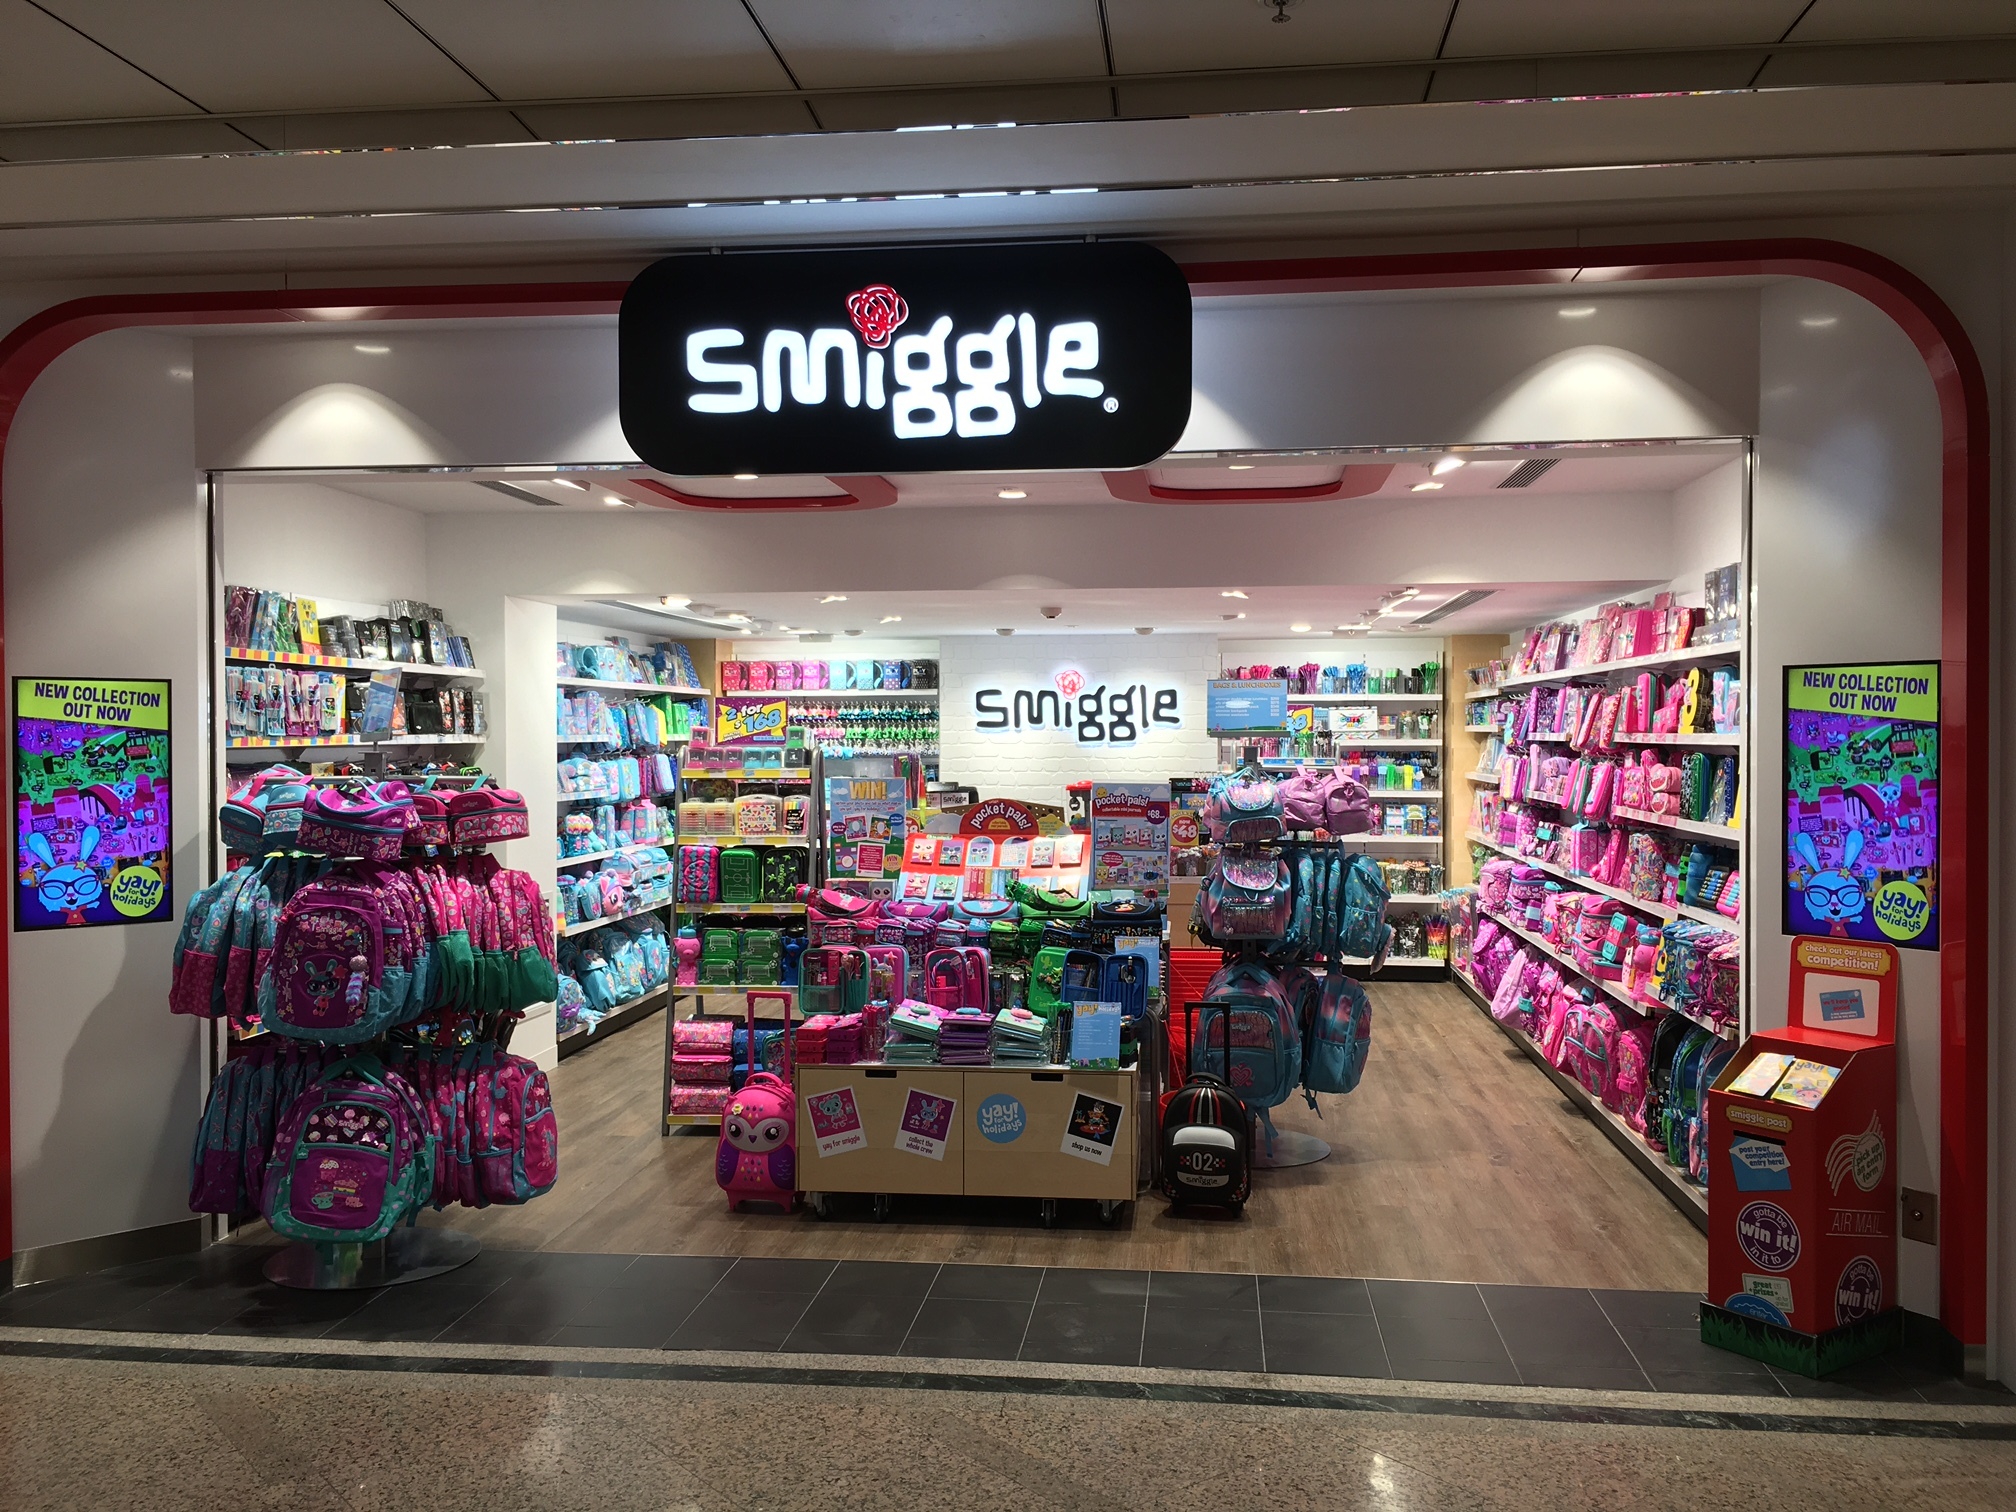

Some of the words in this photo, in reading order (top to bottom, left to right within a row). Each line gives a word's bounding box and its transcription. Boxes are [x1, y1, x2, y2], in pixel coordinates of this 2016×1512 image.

[686, 312, 1105, 439] smiggle
[1803, 671, 1835, 689] NEW
[1838, 673, 1929, 695] COLLECTION
[34, 682, 69, 699] NEW
[72, 685, 161, 708] COLLECTION
[1829, 692, 1858, 710] OUT
[1861, 694, 1898, 713] NOW
[63, 702, 92, 719] OUT
[96, 705, 131, 722] NOW
[725, 708, 738, 721] 2
[741, 703, 763, 718] for
[975, 685, 1180, 742] smiggle
[849, 781, 887, 800] WIN!
[1095, 793, 1128, 809] pocket
[1127, 794, 1150, 807] pals!
[971, 802, 1004, 831] pocket
[1006, 807, 1032, 830] pals!
[1147, 809, 1160, 819] $68
[1172, 824, 1197, 838] $48
[117, 875, 162, 897] yay!
[112, 890, 156, 909] holidays
[1879, 889, 1927, 919] yay!
[1875, 905, 1921, 933] holidays
[1891, 906, 1904, 914] for
[1805, 944, 1827, 953] check
[1859, 949, 1882, 959] latest
[1807, 955, 1879, 971] competition!
[1075, 1003, 1098, 1017] yay!
[1794, 1061, 1825, 1073] yay!
[982, 1102, 1019, 1126] yay!
[1730, 1110, 1765, 1124] smiggle
[1766, 1116, 1787, 1128] post
[981, 1119, 1023, 1134] holidays
[822, 1141, 832, 1151] yay
[832, 1139, 841, 1147] for
[841, 1135, 861, 1146] smiggle
[905, 1142, 920, 1151] whole
[920, 1146, 934, 1155] crew
[908, 1136, 925, 1146] collect
[925, 1140, 934, 1148] the
[1071, 1141, 1084, 1152] shop
[1091, 1148, 1103, 1156] now
[1738, 1146, 1754, 1154] post
[1754, 1146, 1770, 1154] your
[1192, 1152, 1213, 1171] 02
[1744, 1150, 1785, 1160] competition
[1749, 1158, 1767, 1167] entry
[1767, 1157, 1785, 1166] here!
[1856, 1149, 1870, 1166] pick
[1871, 1144, 1880, 1156] up
[1856, 1166, 1866, 1176] an
[1867, 1152, 1884, 1170] entry
[1862, 1167, 1879, 1182] form
[1753, 1208, 1776, 1220] gotta
[1777, 1213, 1788, 1229] be
[1831, 1212, 1852, 1232] AIR
[1855, 1212, 1882, 1234] MAIL
[1739, 1220, 1771, 1244] win
[1776, 1229, 1798, 1253] it!
[1750, 1245, 1761, 1259] in
[1761, 1254, 1770, 1264] it
[1770, 1254, 1781, 1264] to
[1849, 1264, 1866, 1280] gotta
[1866, 1267, 1875, 1282] be
[1752, 1280, 1772, 1290] great
[1753, 1288, 1775, 1297] prizes
[1838, 1285, 1861, 1307] win
[1863, 1288, 1880, 1311] it!
